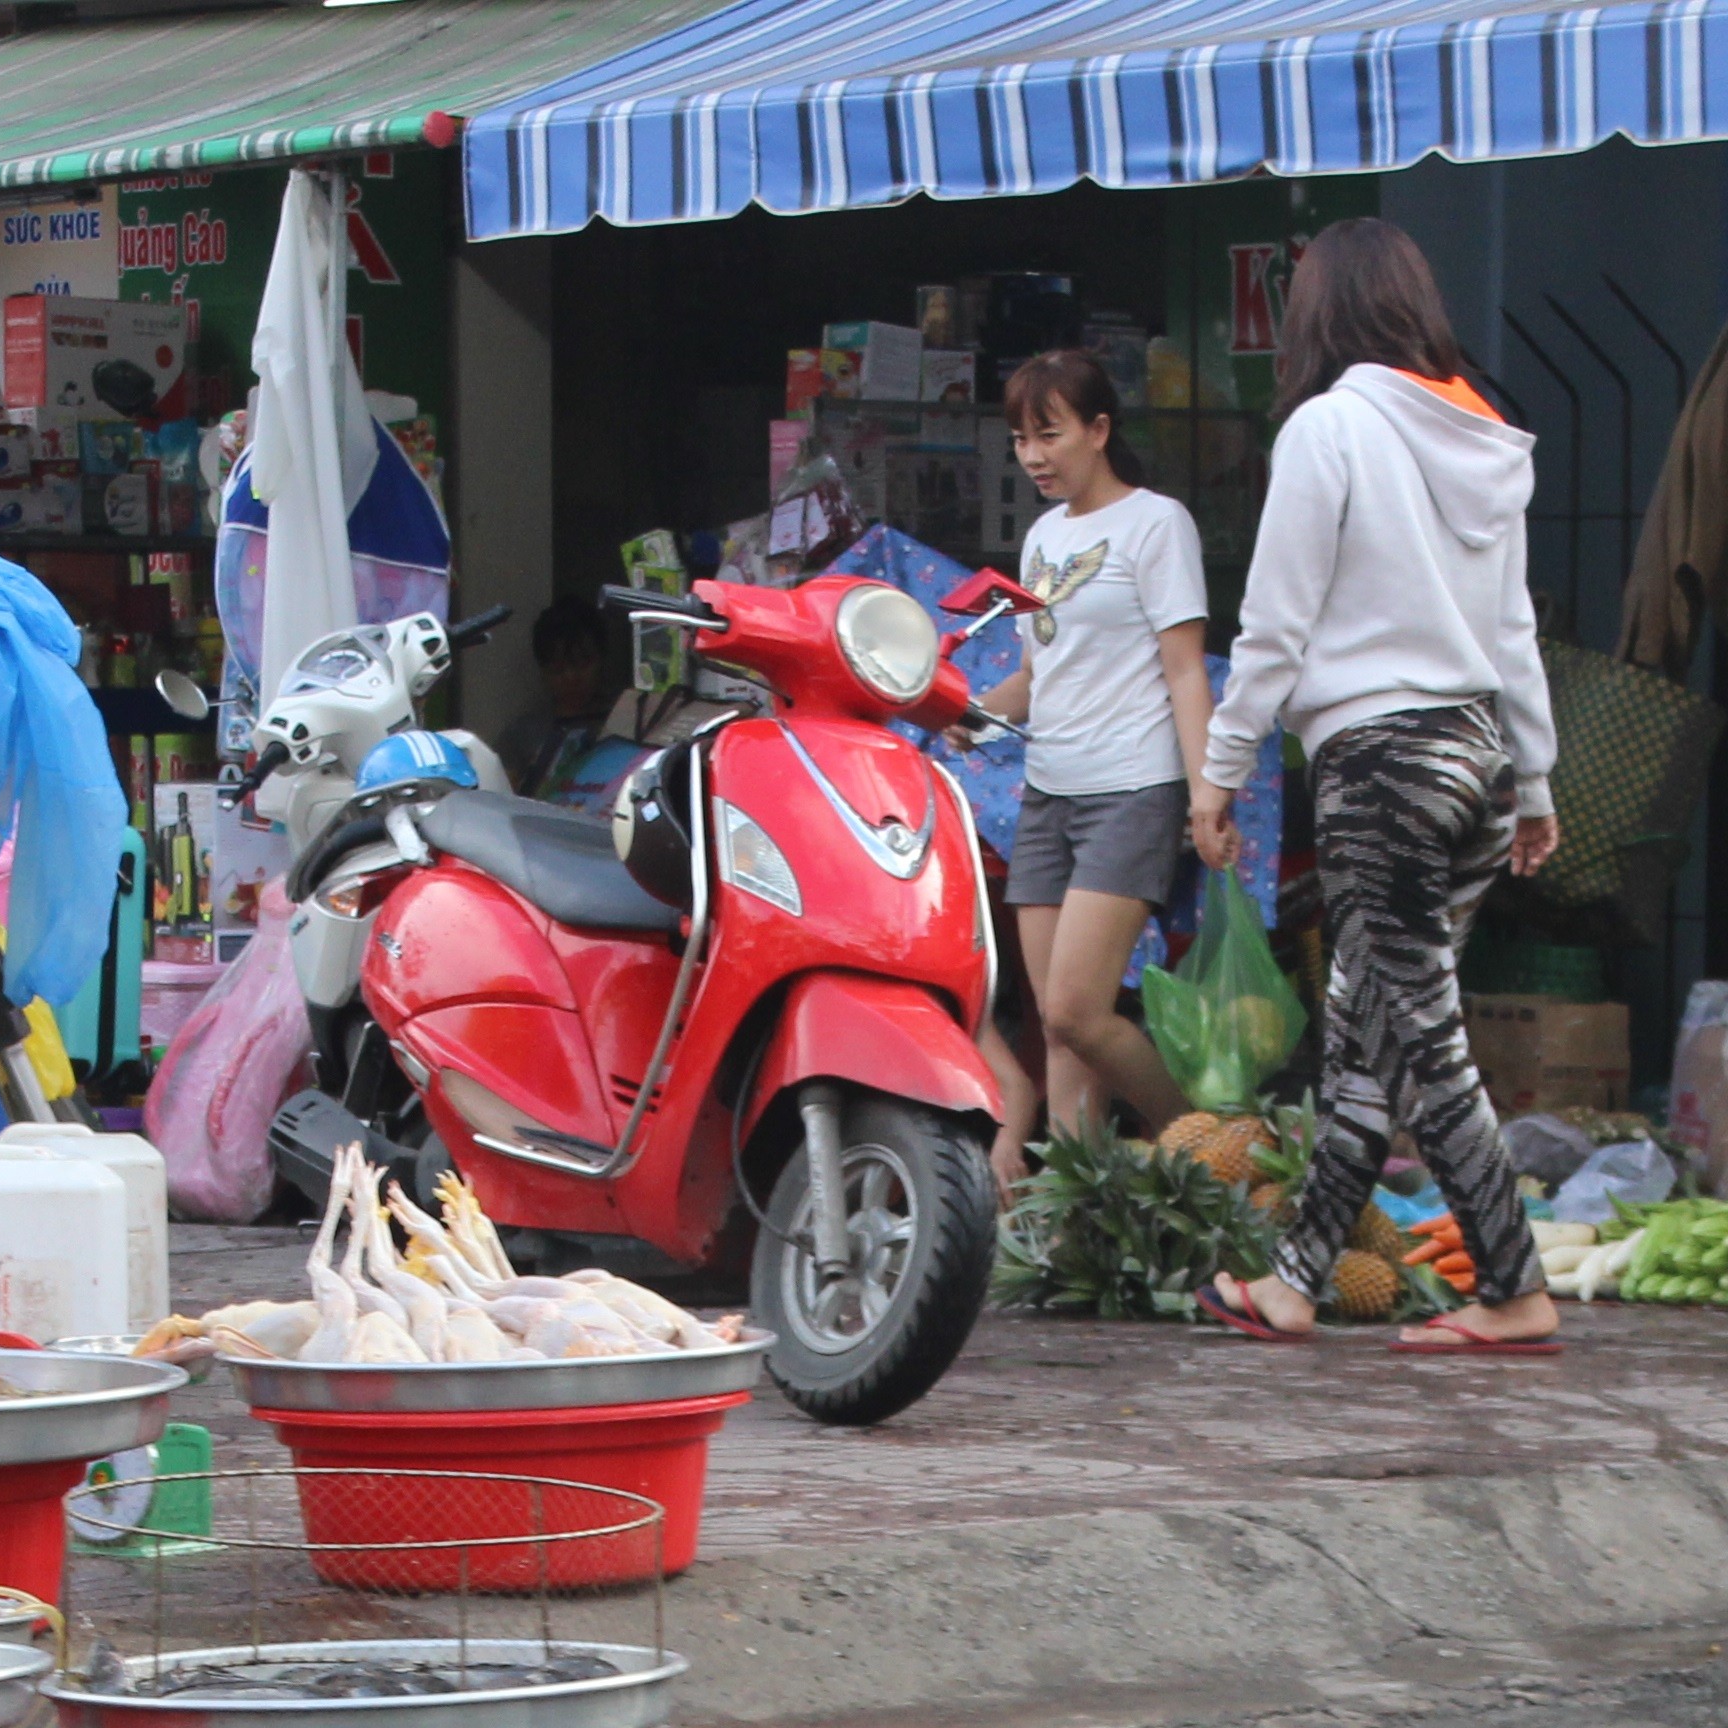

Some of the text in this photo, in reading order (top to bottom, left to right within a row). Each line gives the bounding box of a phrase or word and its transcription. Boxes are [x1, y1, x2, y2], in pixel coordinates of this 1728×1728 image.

[3, 203, 101, 246] SỨC KHỎE
[118, 206, 227, 276] uảng Cáo
